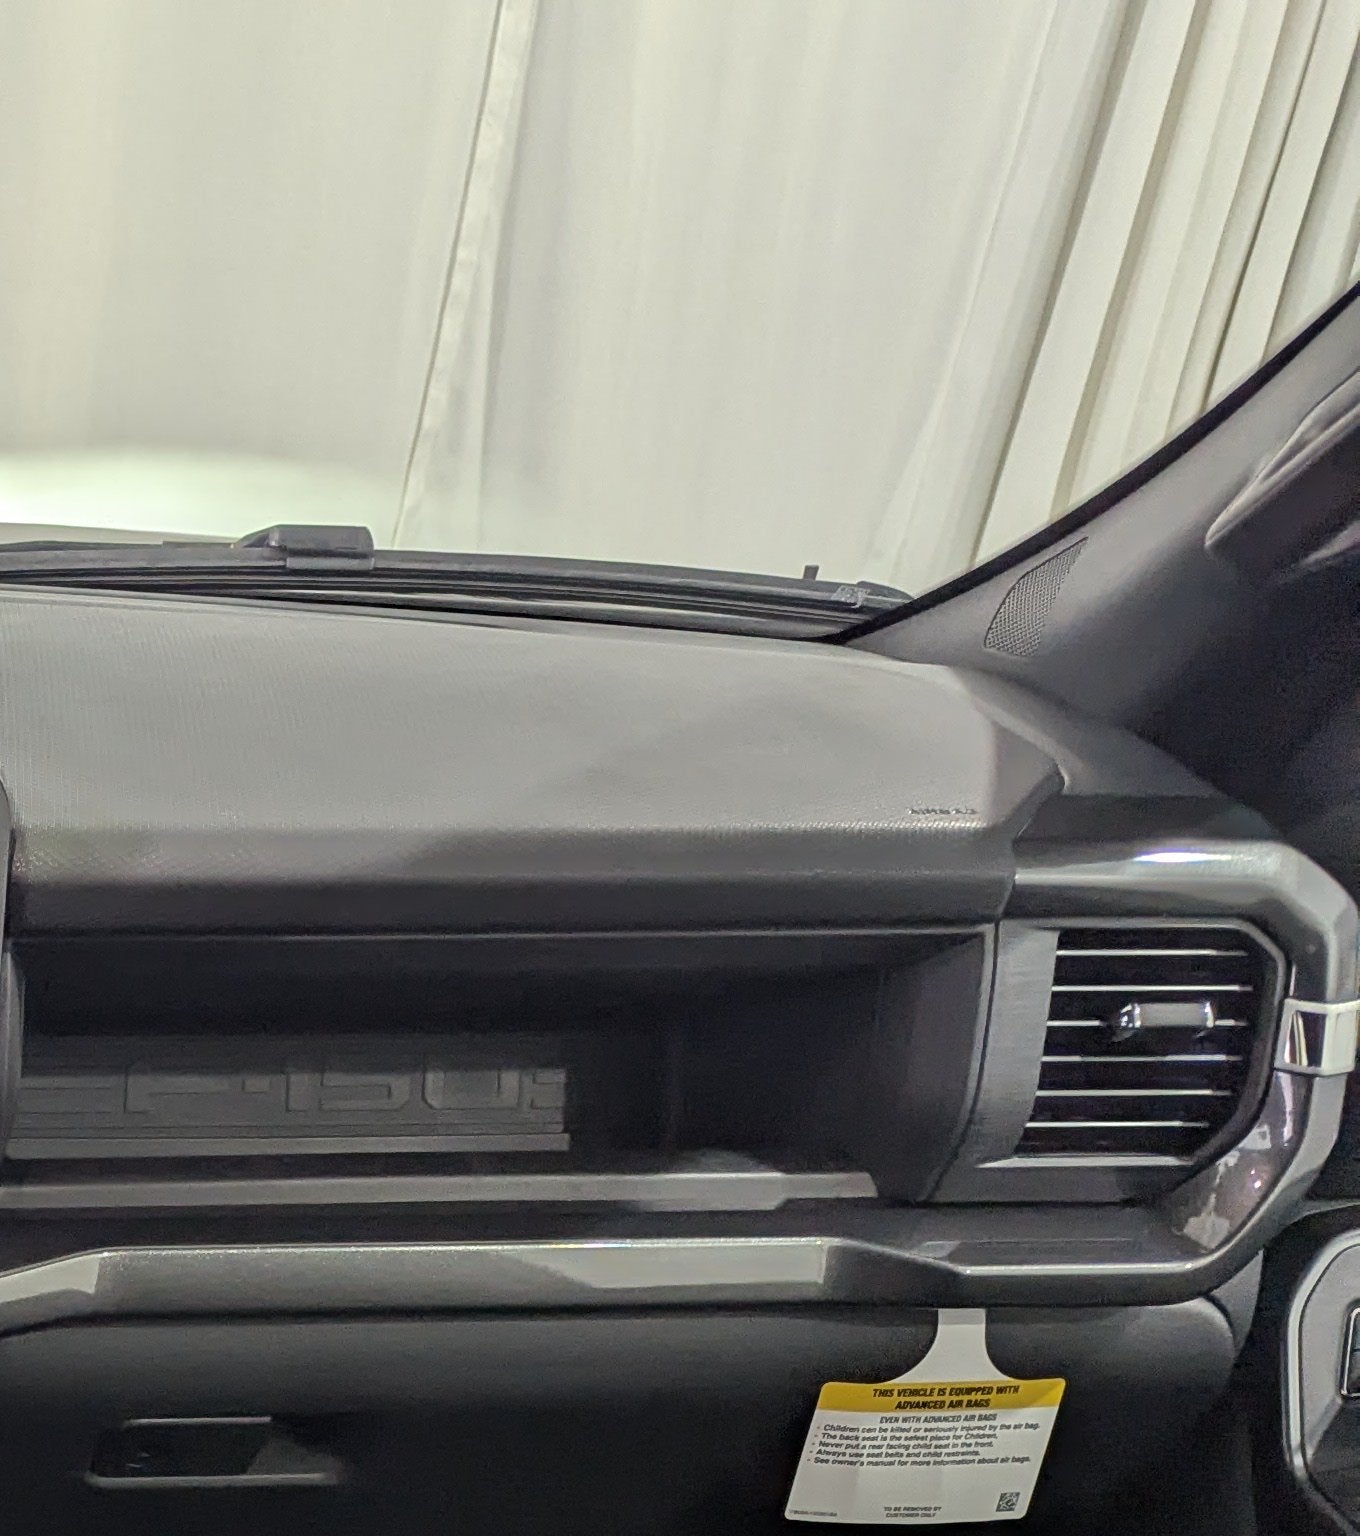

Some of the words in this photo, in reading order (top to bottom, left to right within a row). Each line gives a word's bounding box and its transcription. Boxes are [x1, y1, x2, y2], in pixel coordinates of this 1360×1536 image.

[873, 1388, 894, 1398] THIS
[897, 1388, 935, 1397] VEHICLE
[937, 1387, 947, 1397] IS
[949, 1386, 994, 1397] EQUIPPED
[995, 1385, 1020, 1395] WITH
[895, 1400, 946, 1410] ADVANCED
[966, 1398, 991, 1408] BAGS
